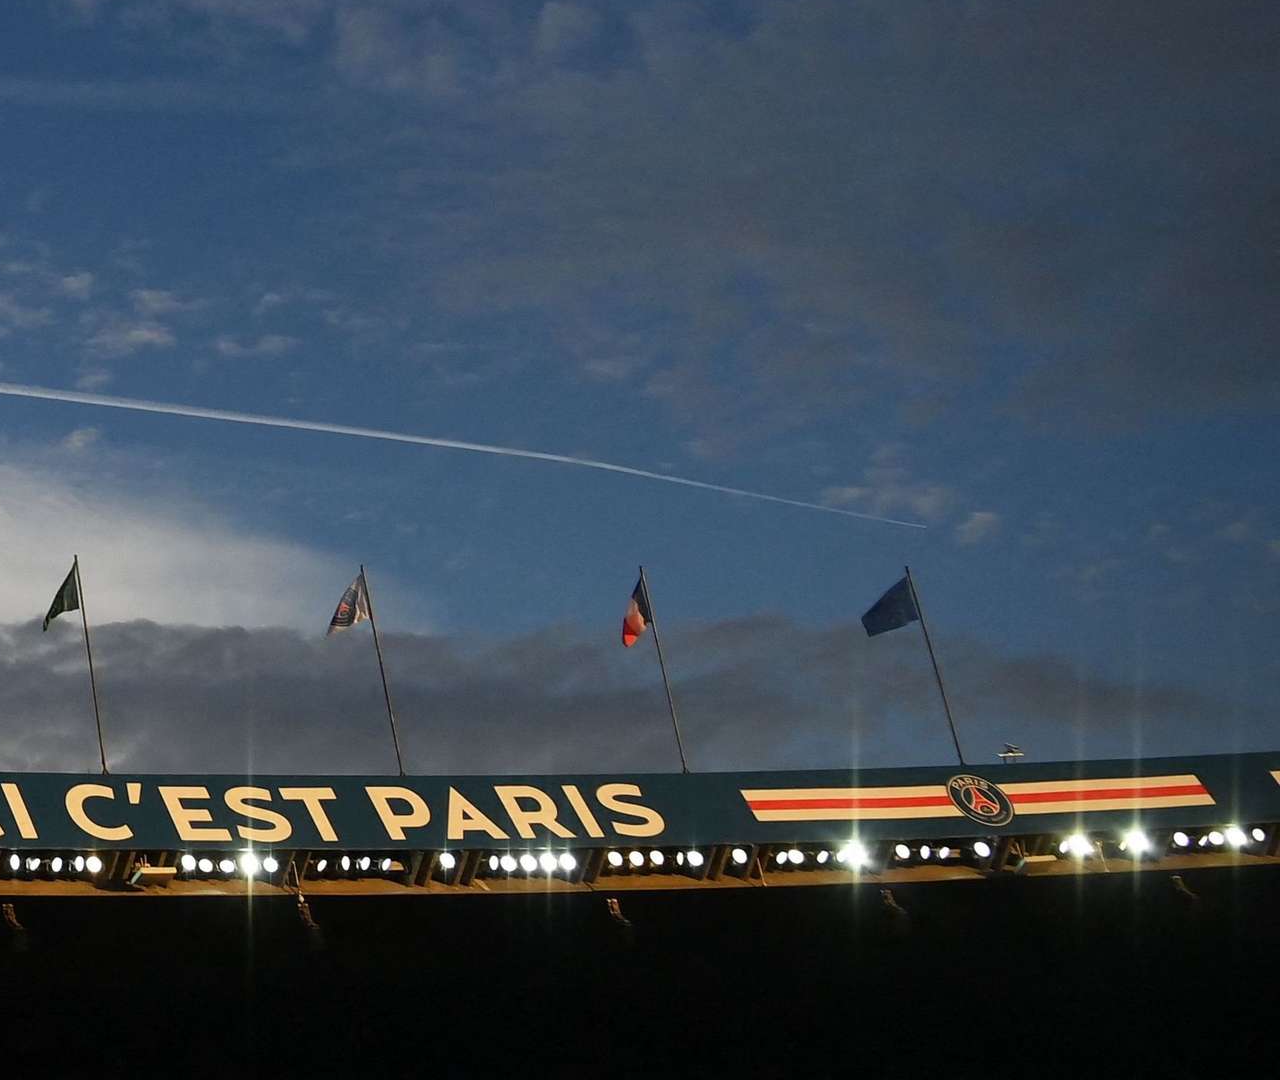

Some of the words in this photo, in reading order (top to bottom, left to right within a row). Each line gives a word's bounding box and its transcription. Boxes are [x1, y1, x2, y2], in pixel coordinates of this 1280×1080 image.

[952, 777, 989, 790] PARIS
[65, 783, 339, 842] C'EST
[364, 783, 666, 840] PARIS
